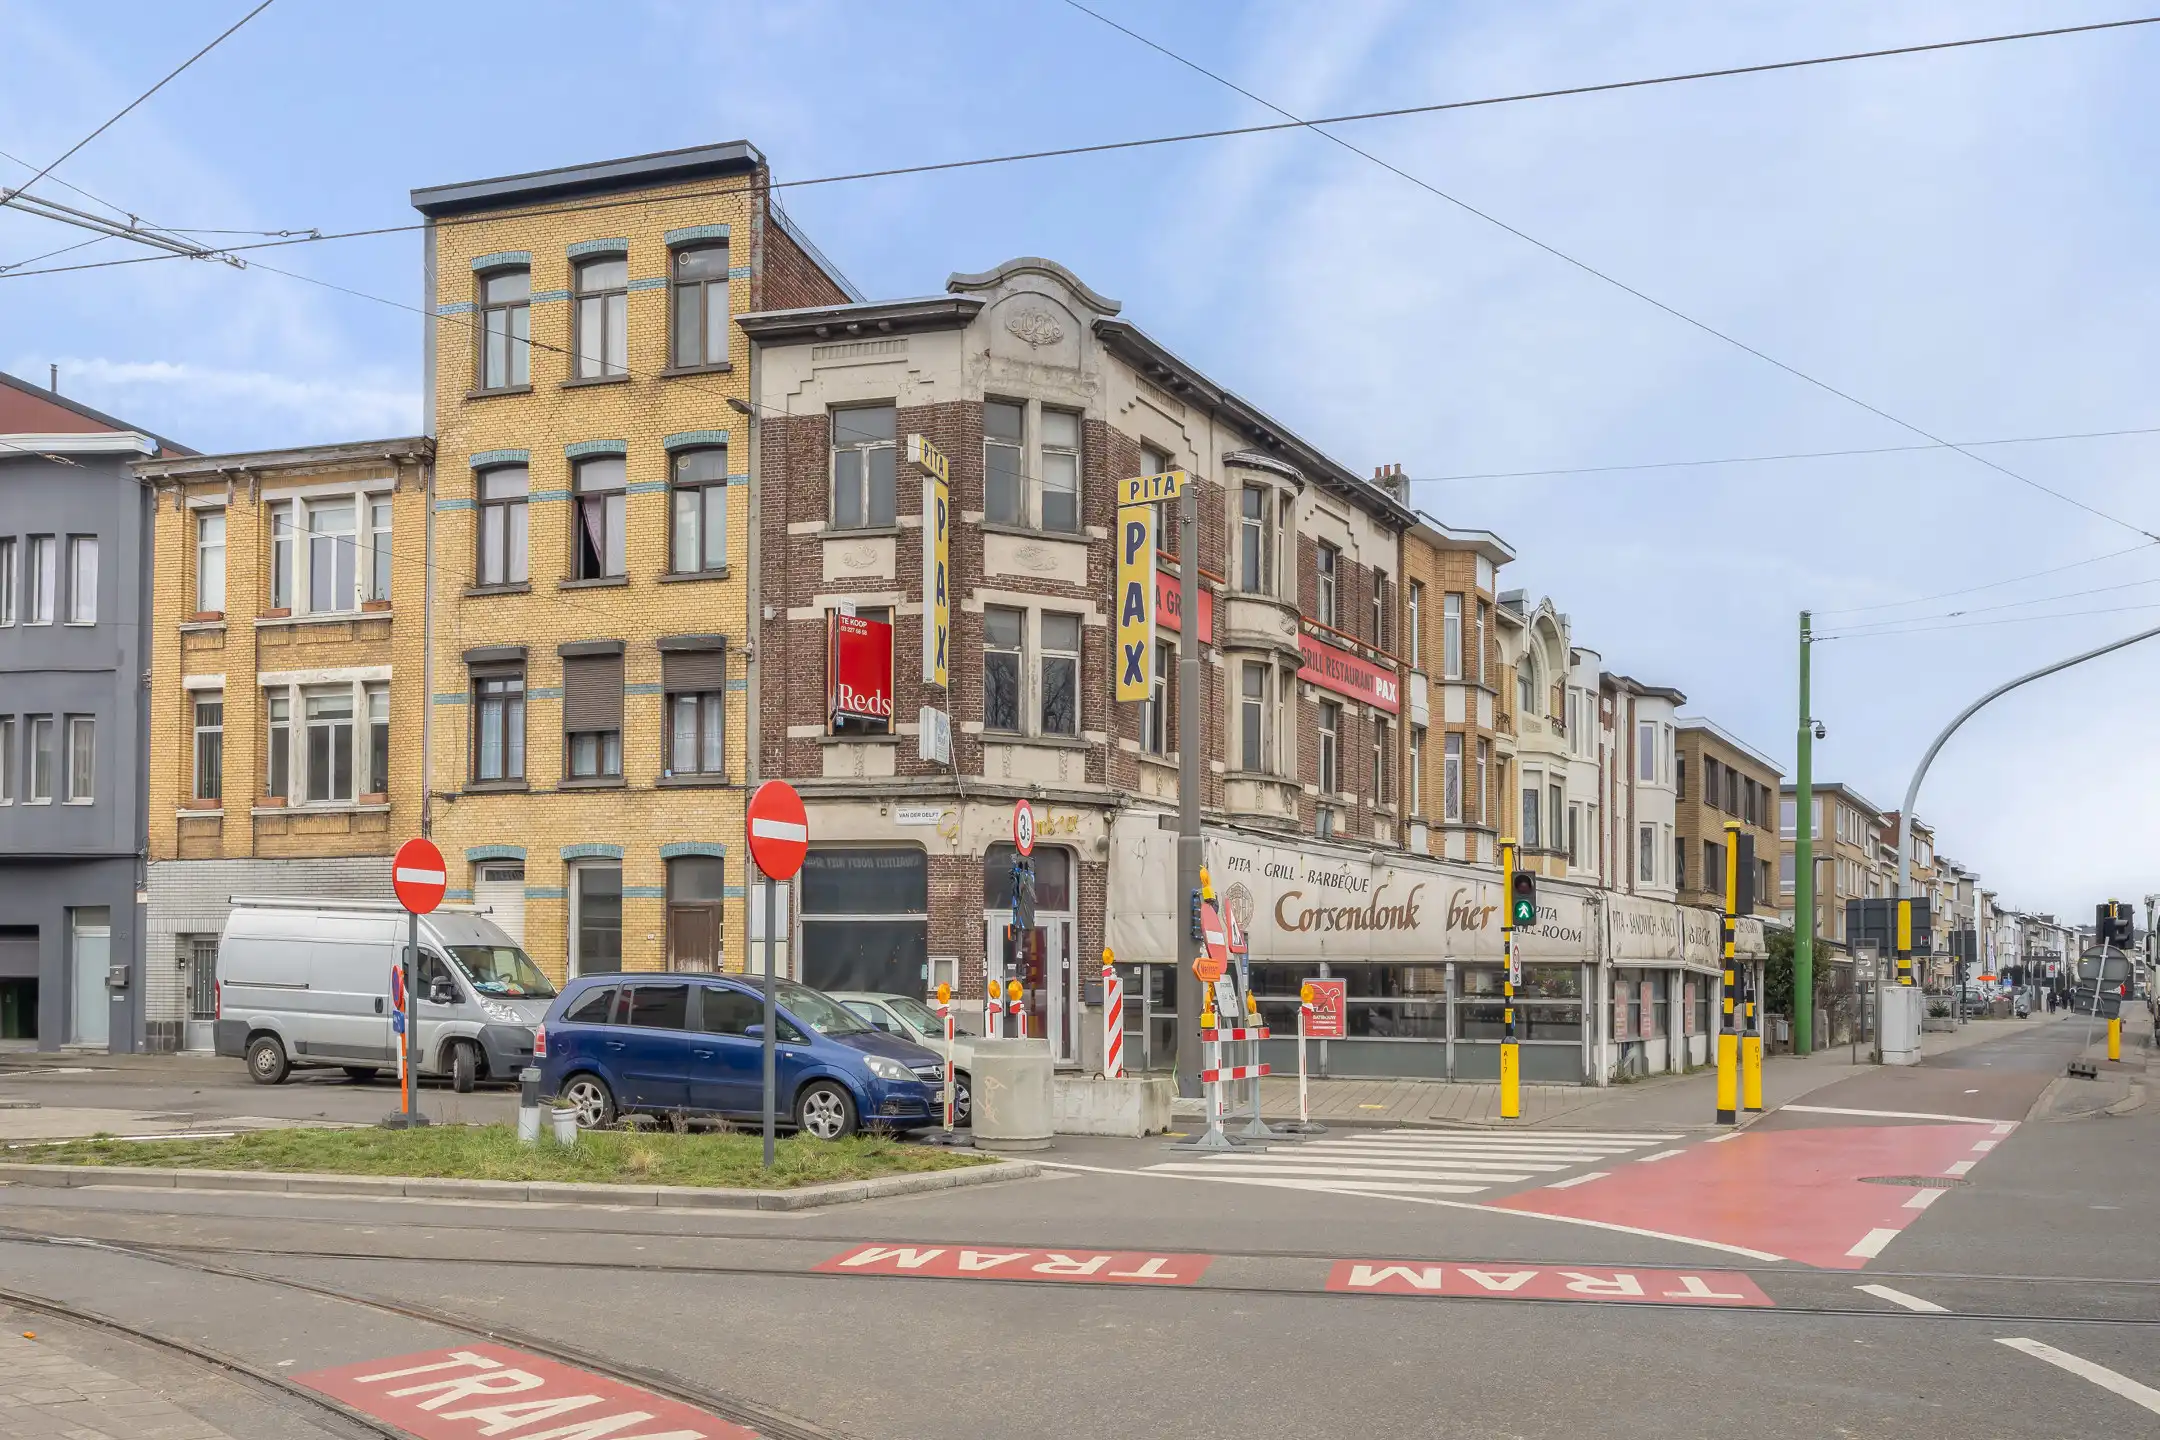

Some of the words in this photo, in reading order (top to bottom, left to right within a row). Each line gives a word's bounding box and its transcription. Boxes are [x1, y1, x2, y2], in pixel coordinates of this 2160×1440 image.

[924, 442, 944, 477] PITA
[1130, 475, 1175, 500] PITA
[936, 497, 946, 670] PAX
[1122, 521, 1146, 686] PAX
[841, 616, 849, 625] TE
[850, 618, 867, 628] KOOP
[1326, 656, 1374, 693] RESTAURANT
[1375, 676, 1396, 703] PAX
[839, 683, 891, 715] Reds
[1227, 856, 1250, 873] PITA
[1264, 862, 1295, 881] GRILL
[1307, 869, 1370, 893] BARBEQUE
[1275, 883, 1426, 932] Corsendonk
[1445, 888, 1498, 932] bier
[1535, 905, 1557, 921] PITA
[1612, 910, 1625, 933] PITA
[1515, 923, 1582, 943] RILL-ROOM
[838, 1247, 1177, 1279] TRAM
[1347, 1264, 1744, 1300] TRAM
